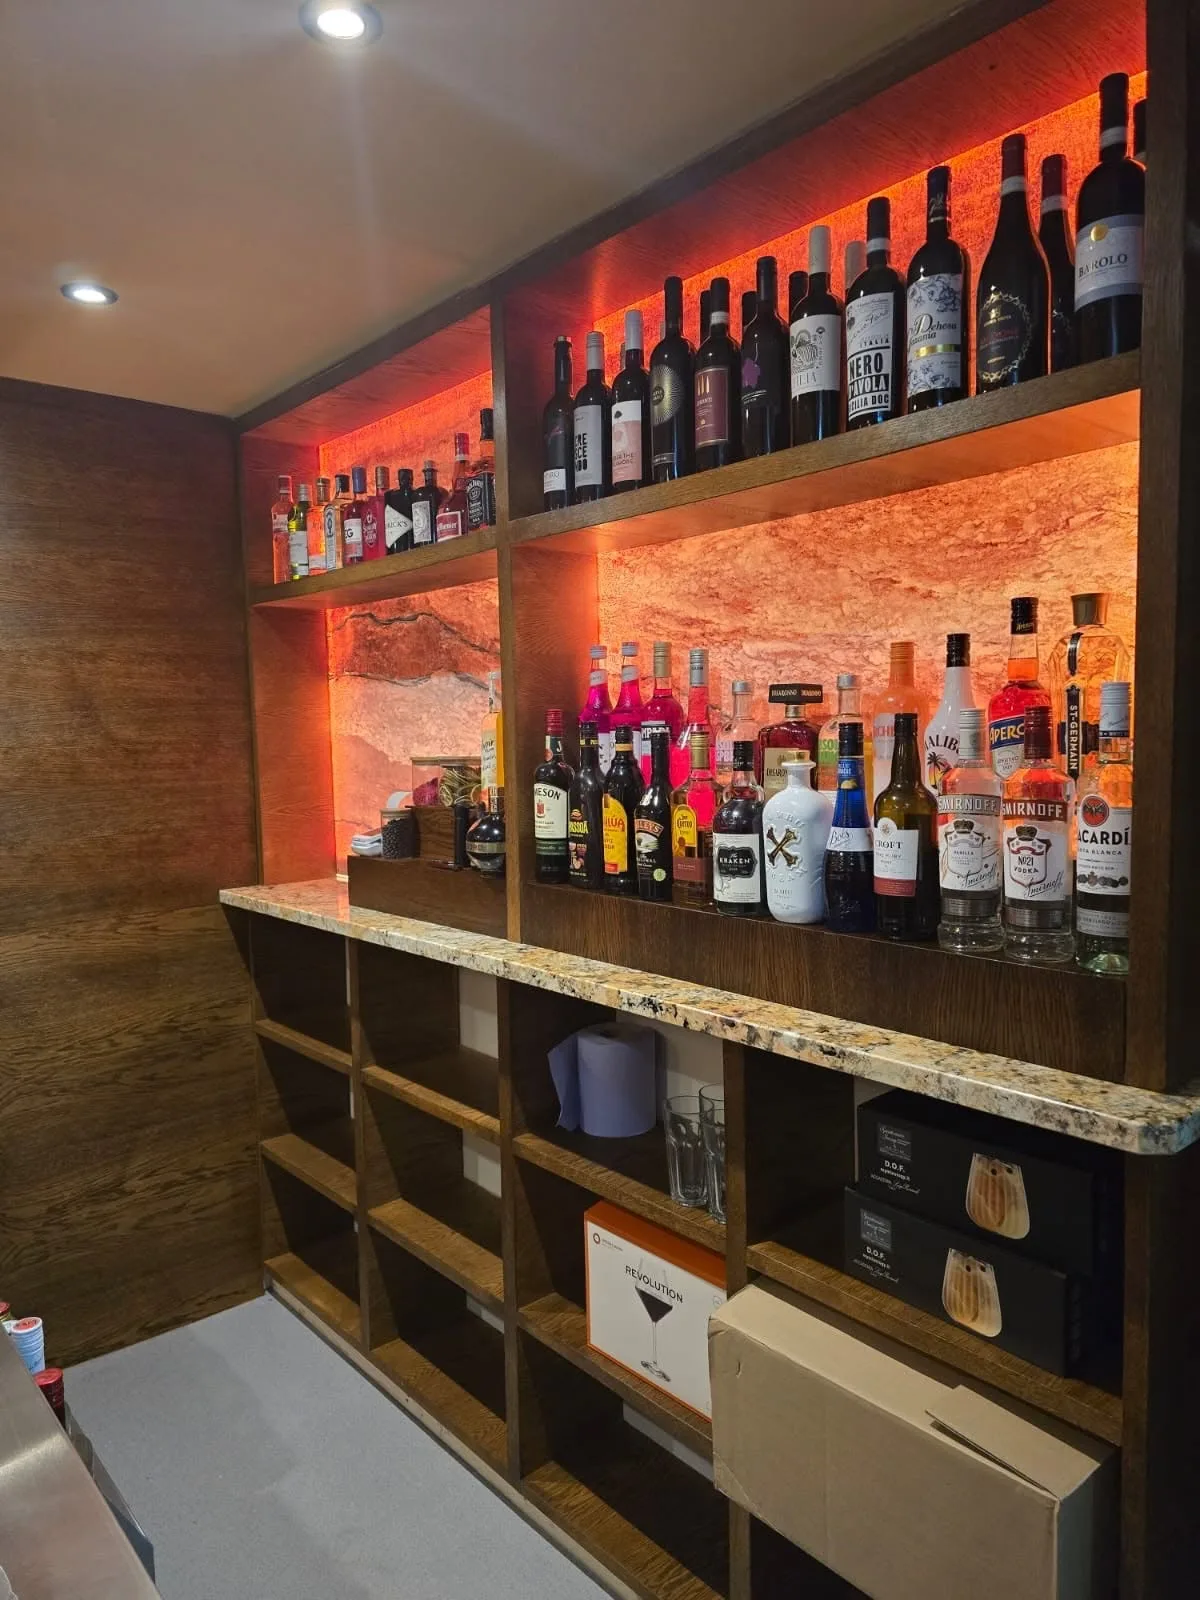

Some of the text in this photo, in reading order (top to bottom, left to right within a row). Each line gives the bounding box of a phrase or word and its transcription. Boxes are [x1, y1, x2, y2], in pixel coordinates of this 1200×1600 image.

[1078, 253, 1128, 278] BAROLO
[849, 352, 883, 380] NERO
[872, 393, 889, 405] DOC
[1069, 704, 1078, 770] ST-GERMAIN
[938, 799, 996, 812] SMIRNOFF
[1002, 802, 1063, 818] SMIRNOFF
[719, 857, 750, 865] KRAKEN
[1013, 866, 1039, 874] VODKA
[625, 1265, 684, 1304] REVOLUTION
